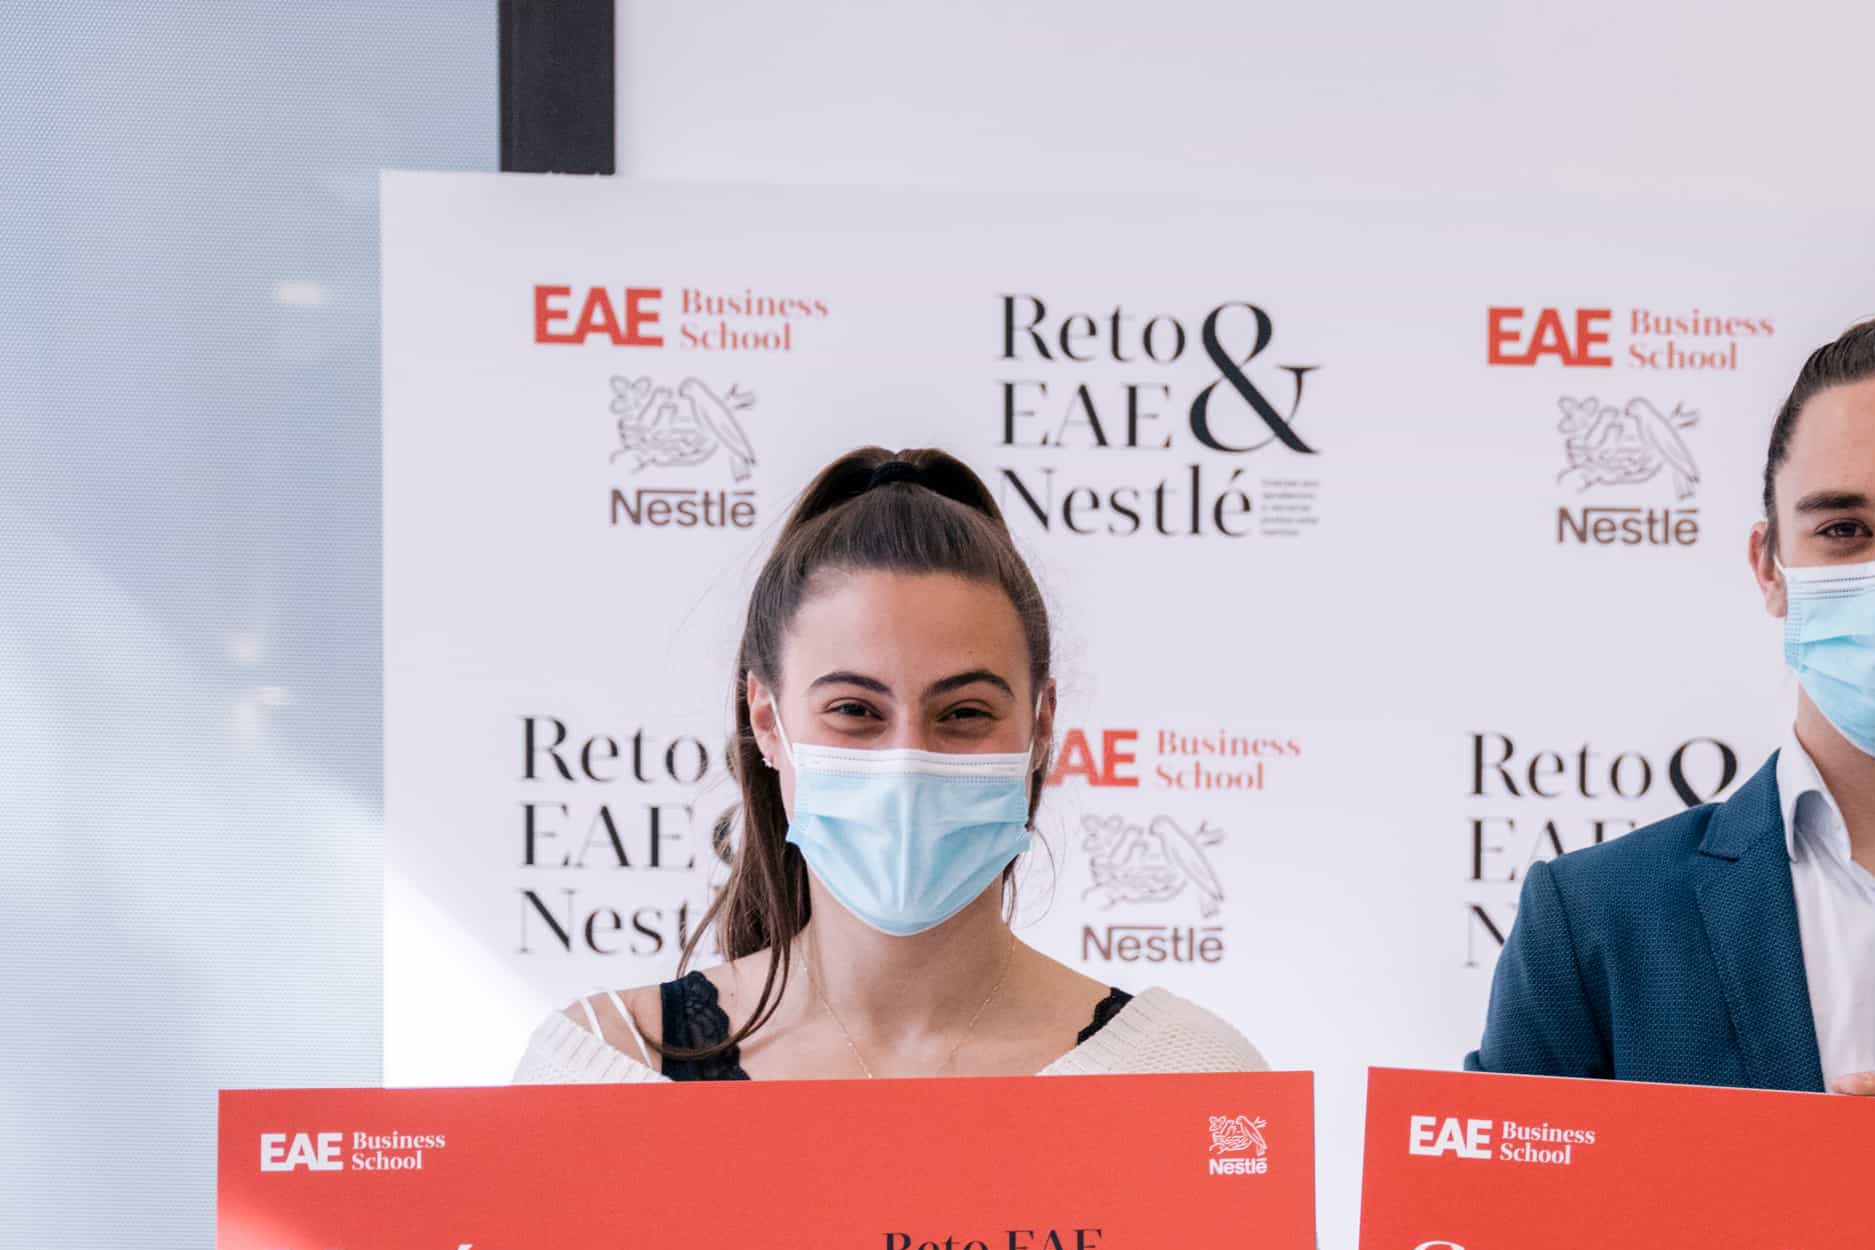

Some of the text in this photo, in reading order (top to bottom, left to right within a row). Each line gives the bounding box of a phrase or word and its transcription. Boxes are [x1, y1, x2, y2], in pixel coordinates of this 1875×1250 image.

[534, 285, 829, 347] EAE Business
[680, 318, 792, 351] School
[996, 293, 1186, 364] Reto
[1487, 307, 1774, 368] EAE Business
[1189, 301, 1322, 454] &
[1628, 340, 1737, 371] School
[999, 381, 1172, 450] EAE
[610, 488, 756, 528] Nestlé
[996, 464, 1252, 538] Nestlé
[1556, 507, 1699, 546] Nestlé
[516, 715, 710, 784] Reto
[1466, 731, 1653, 799] Reto
[520, 803, 695, 868] EAE
[1081, 925, 1224, 964] Nestlé
[261, 1131, 445, 1171] EAE Business
[1408, 1115, 1595, 1159] EAE Business
[1500, 1142, 1571, 1165] School
[352, 1151, 422, 1170] School
[1209, 1158, 1267, 1175] Nestlé
